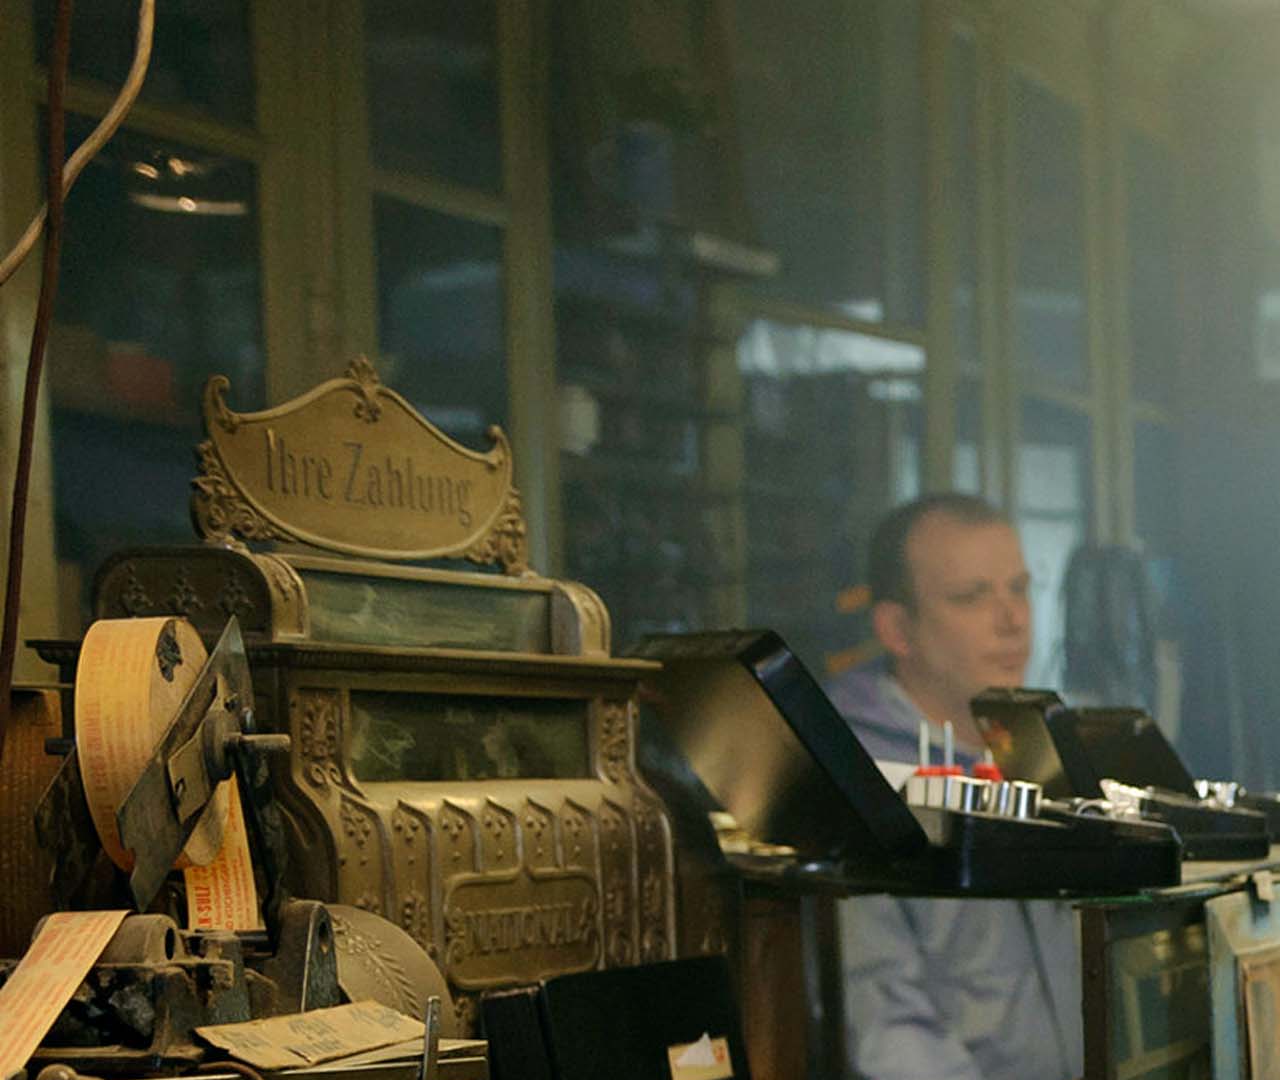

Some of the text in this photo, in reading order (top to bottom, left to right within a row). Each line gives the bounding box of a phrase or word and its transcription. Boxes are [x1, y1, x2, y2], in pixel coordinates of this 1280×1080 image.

[265, 428, 473, 526] Ihre Zahlung
[464, 904, 581, 957] NATIONAL
